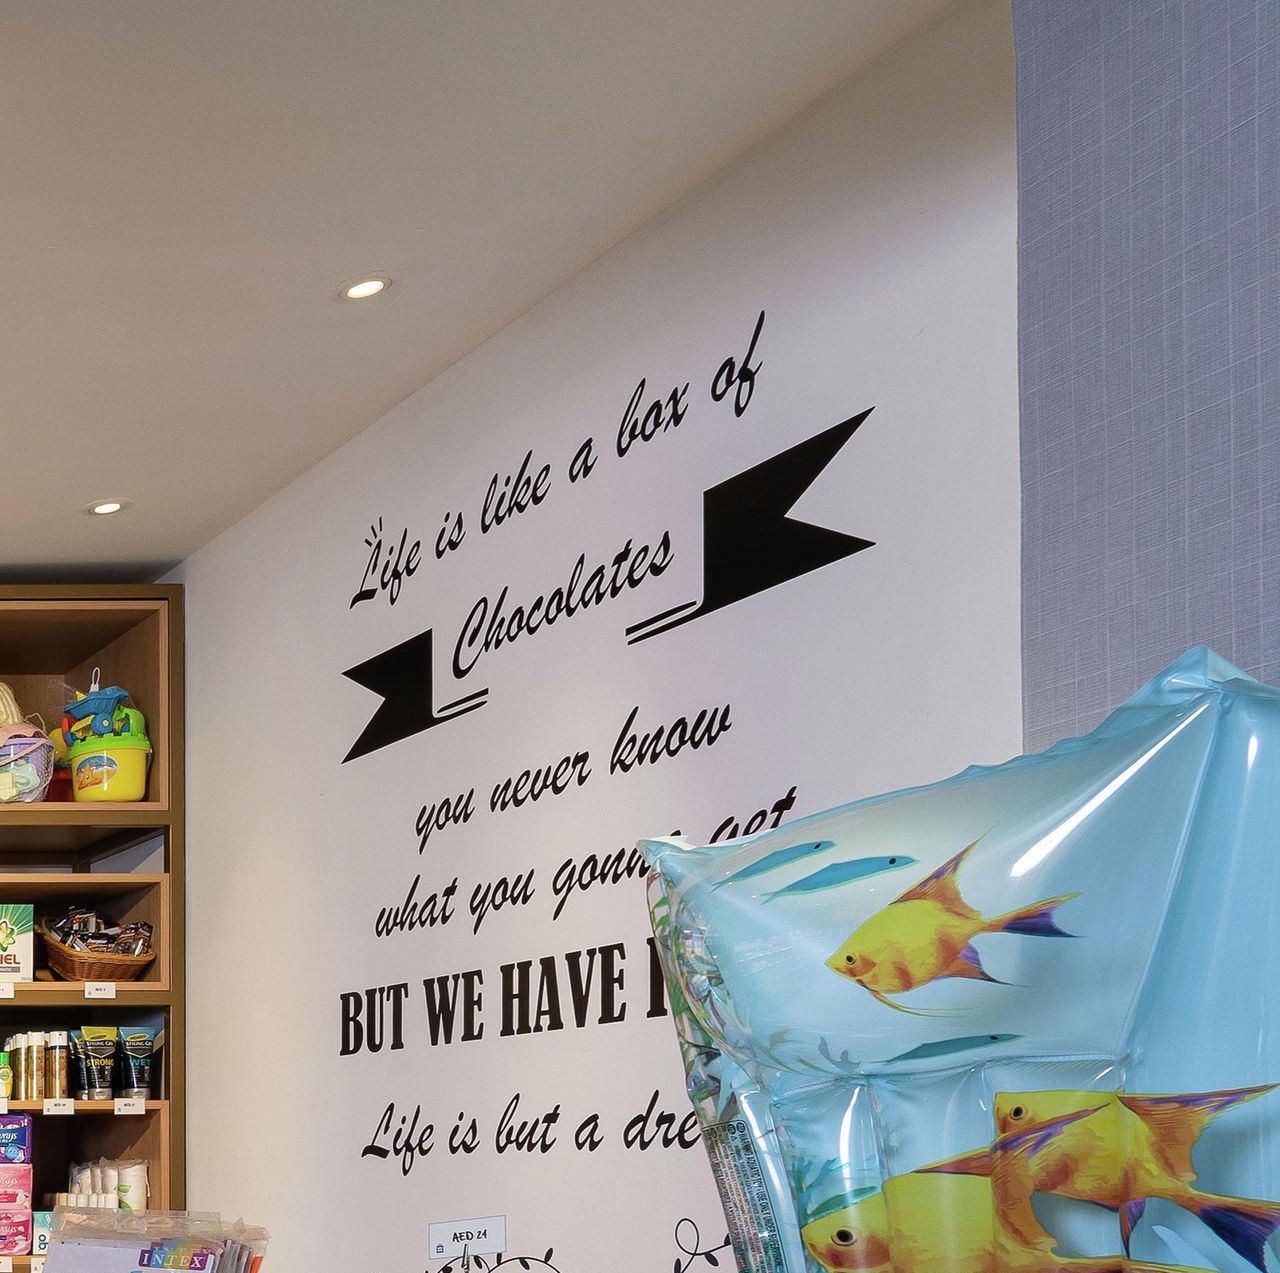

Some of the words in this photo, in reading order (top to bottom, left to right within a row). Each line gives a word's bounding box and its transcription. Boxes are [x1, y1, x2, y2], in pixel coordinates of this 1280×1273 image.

[350, 527, 421, 609] Life
[436, 510, 465, 560] is
[480, 450, 551, 534] like
[569, 437, 597, 483] a
[616, 378, 689, 458] box
[711, 310, 765, 417] of
[452, 530, 675, 679] Chocolates
[415, 787, 474, 855] you
[490, 751, 593, 812] never
[610, 704, 733, 775] know
[374, 875, 458, 937] what
[469, 869, 535, 935] you
[552, 832, 678, 921] gonn
[339, 983, 409, 1057] BUT
[422, 968, 485, 1047] WE
[499, 943, 627, 1038] HAVE
[361, 1102, 435, 1176] Life
[449, 1112, 481, 1155] is
[495, 1093, 563, 1155] but
[575, 1113, 604, 1153] a
[623, 1089, 701, 1153] dre
[142, 1250, 206, 1269] INTEX
[452, 1230, 474, 1243] AED
